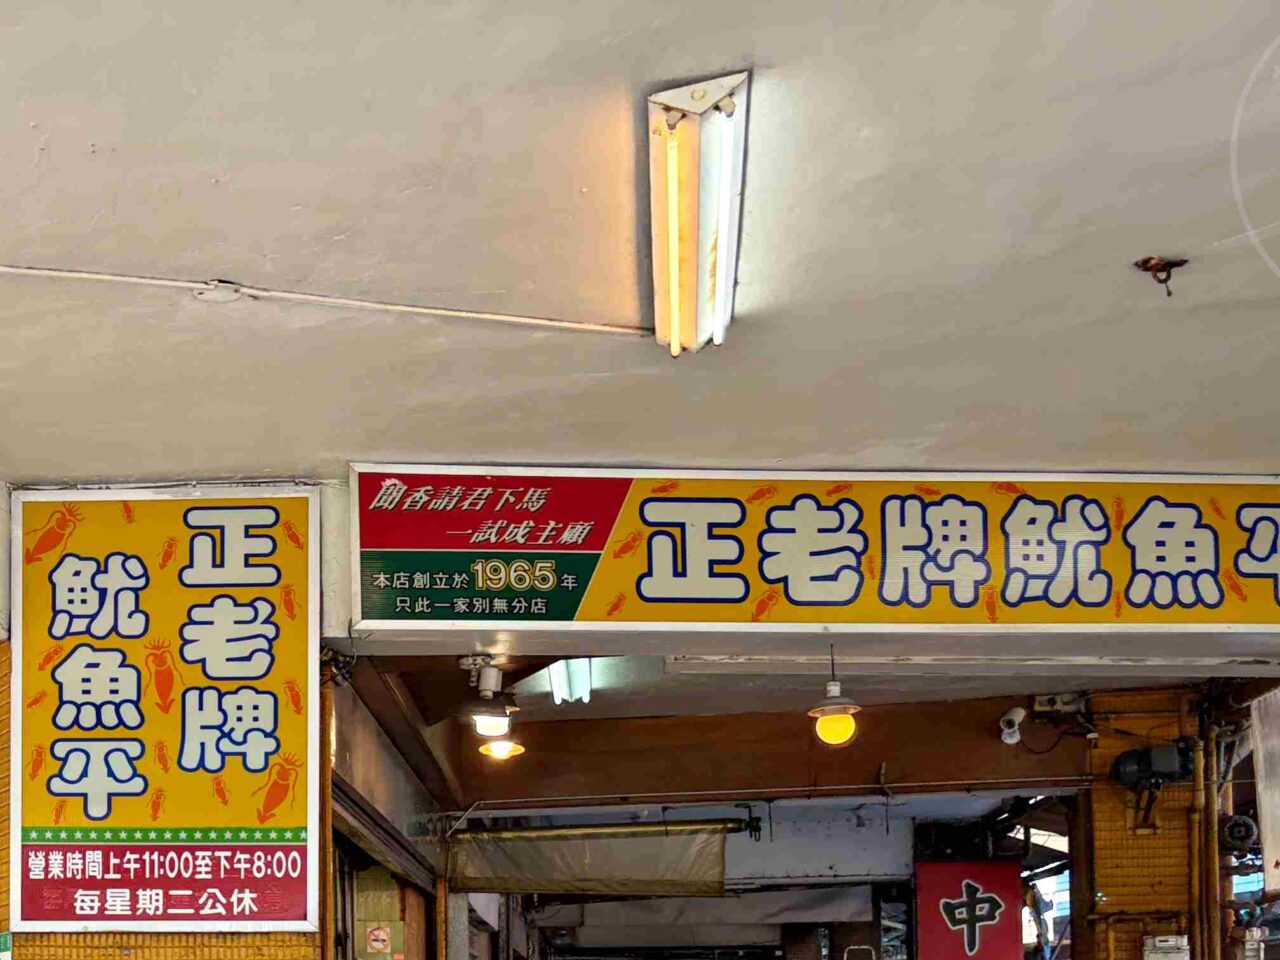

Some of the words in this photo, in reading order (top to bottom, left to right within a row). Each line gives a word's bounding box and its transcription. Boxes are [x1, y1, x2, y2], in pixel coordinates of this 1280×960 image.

[369, 483, 552, 513] 聞香請君下馬
[446, 519, 596, 546] 一試成主顧
[373, 558, 578, 592] 本店創立於1965年
[395, 596, 548, 615] 只此一家別無分店
[177, 505, 281, 773] 正老牌
[46, 551, 150, 821] 魷魚平
[27, 850, 302, 880] 營業時間上午11:00至下午8:00
[73, 888, 259, 916] 每星期二公休
